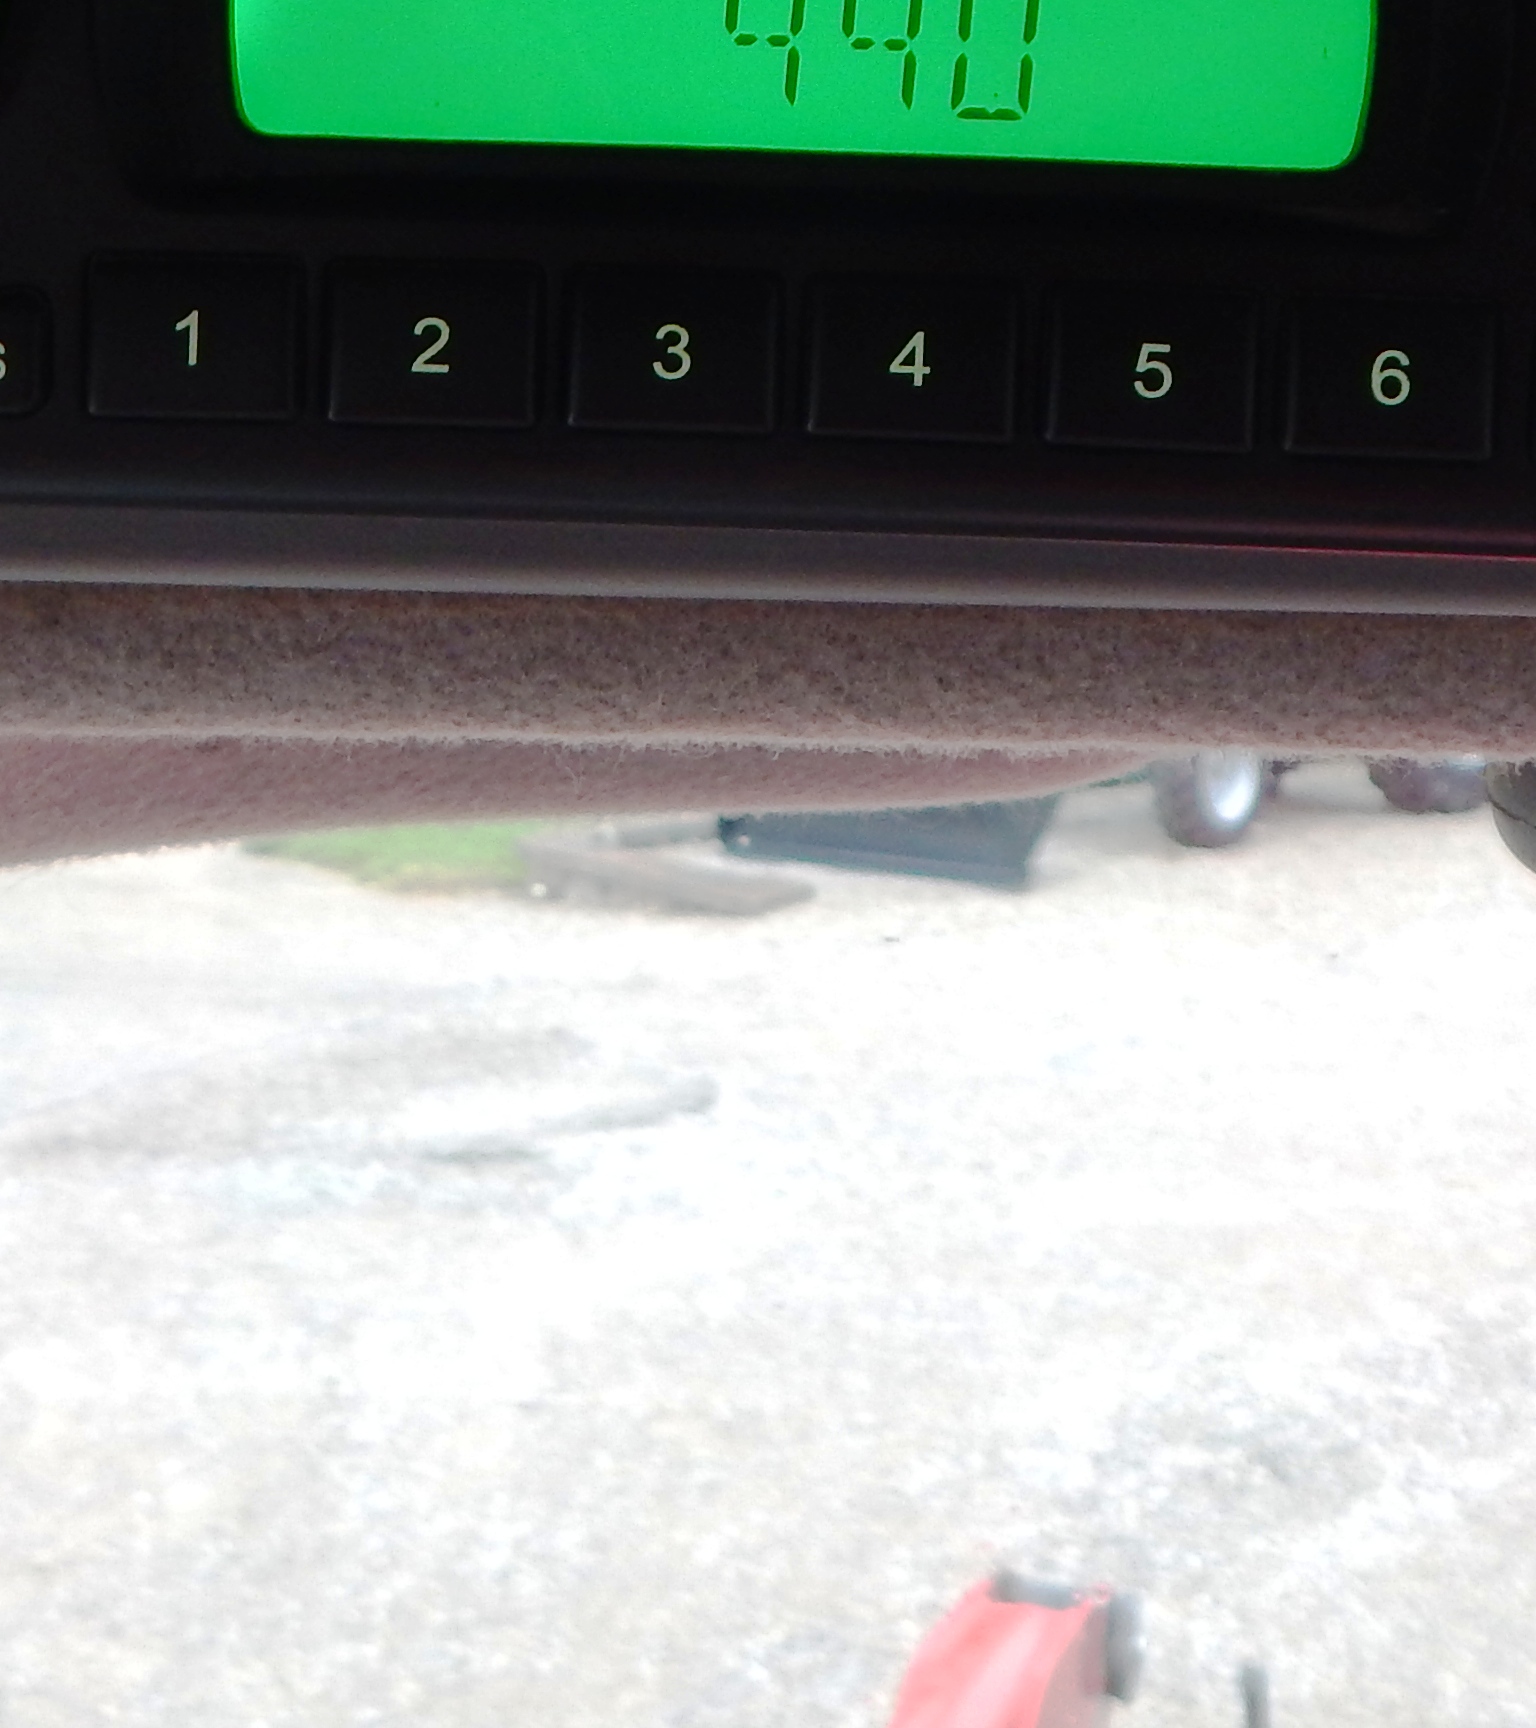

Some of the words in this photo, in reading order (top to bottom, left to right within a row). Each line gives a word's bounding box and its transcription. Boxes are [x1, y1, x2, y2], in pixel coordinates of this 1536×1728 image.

[175, 309, 200, 367] 1
[410, 316, 450, 374] 2
[652, 323, 692, 381] 3
[888, 330, 931, 387] 4
[1133, 342, 1173, 399] 5
[1370, 349, 1411, 406] 6
